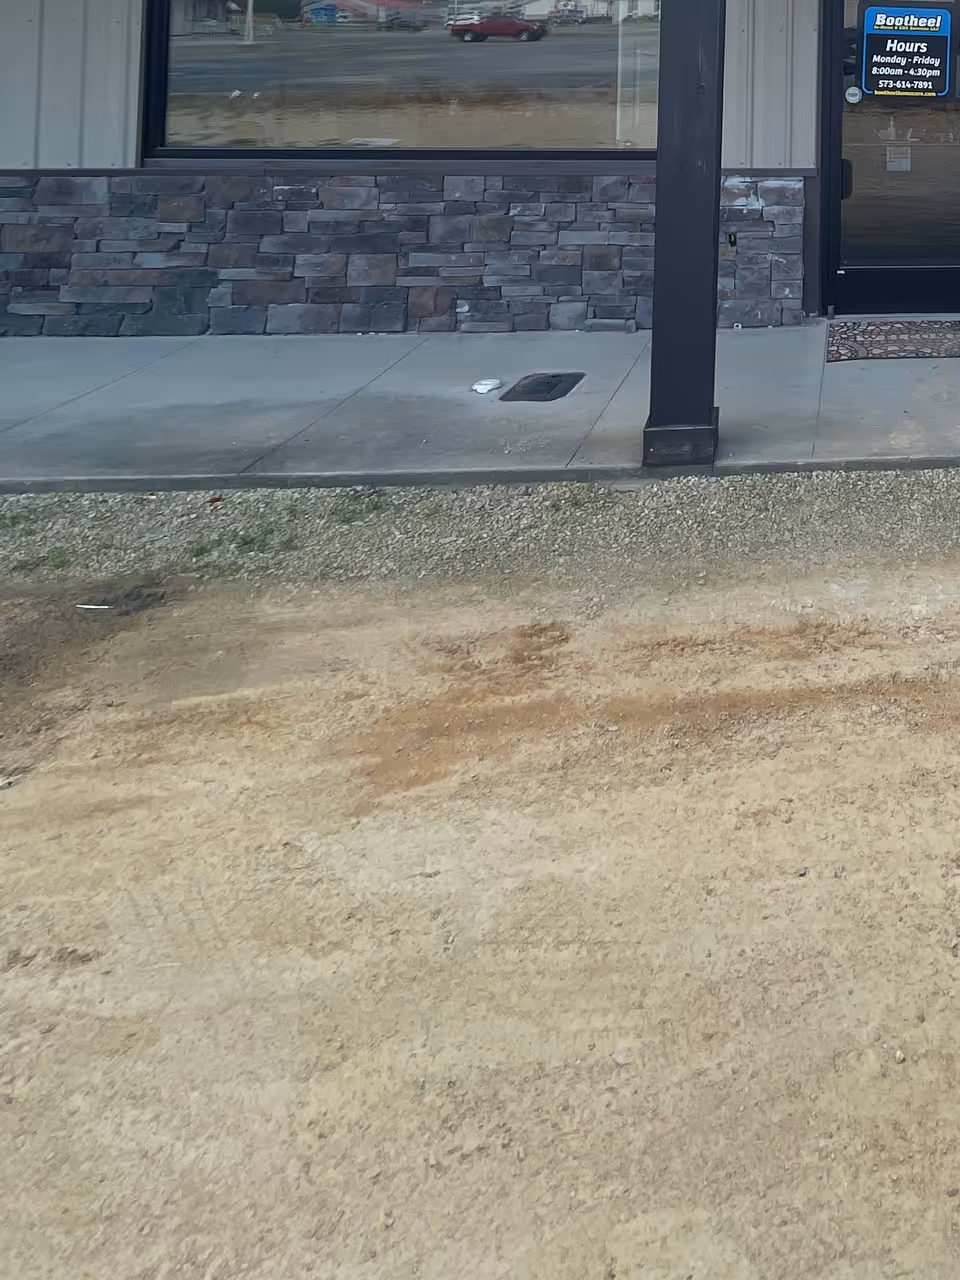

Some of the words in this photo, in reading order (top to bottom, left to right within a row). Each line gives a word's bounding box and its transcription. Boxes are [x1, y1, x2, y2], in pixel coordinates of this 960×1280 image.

[875, 13, 942, 27] Bootheel
[885, 39, 928, 53] Hours
[872, 54, 907, 66] Monday
[913, 55, 941, 67] Friday
[871, 66, 903, 75] 8:00am
[909, 68, 941, 78] 4:30pm
[878, 80, 933, 89] 573-614-7891
